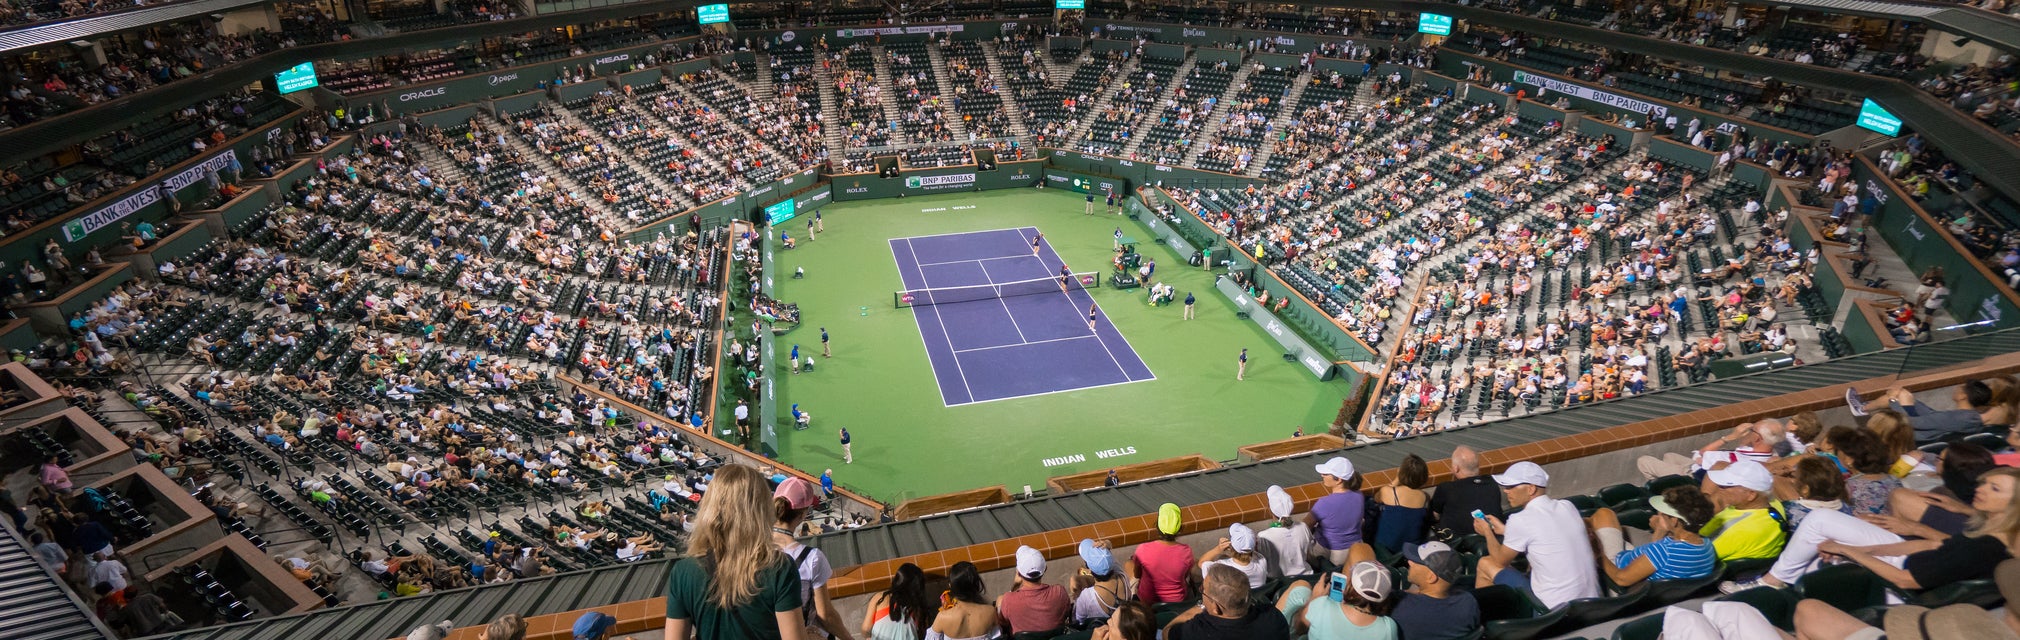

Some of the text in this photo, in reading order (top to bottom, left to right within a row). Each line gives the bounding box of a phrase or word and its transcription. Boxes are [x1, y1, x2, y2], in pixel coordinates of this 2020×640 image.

[596, 54, 629, 65] HEAD
[498, 73, 518, 84] pepsi
[400, 87, 446, 102] ORACLE
[1525, 74, 1547, 86] BANK
[1555, 81, 1580, 95] WEST
[1592, 91, 1614, 103] BNP
[267, 127, 281, 141] ATP
[1155, 164, 1172, 172] ESPN
[172, 171, 193, 190] BNP
[922, 174, 973, 185] BNP PARIBAS
[846, 186, 868, 194] ROLEX
[1866, 179, 1888, 205] ORACLE
[127, 187, 159, 210] WEST
[118, 202, 126, 210] OF
[120, 207, 130, 216] THE
[83, 205, 119, 231] BANK
[1042, 446, 1137, 467] INDIAN WELLS
